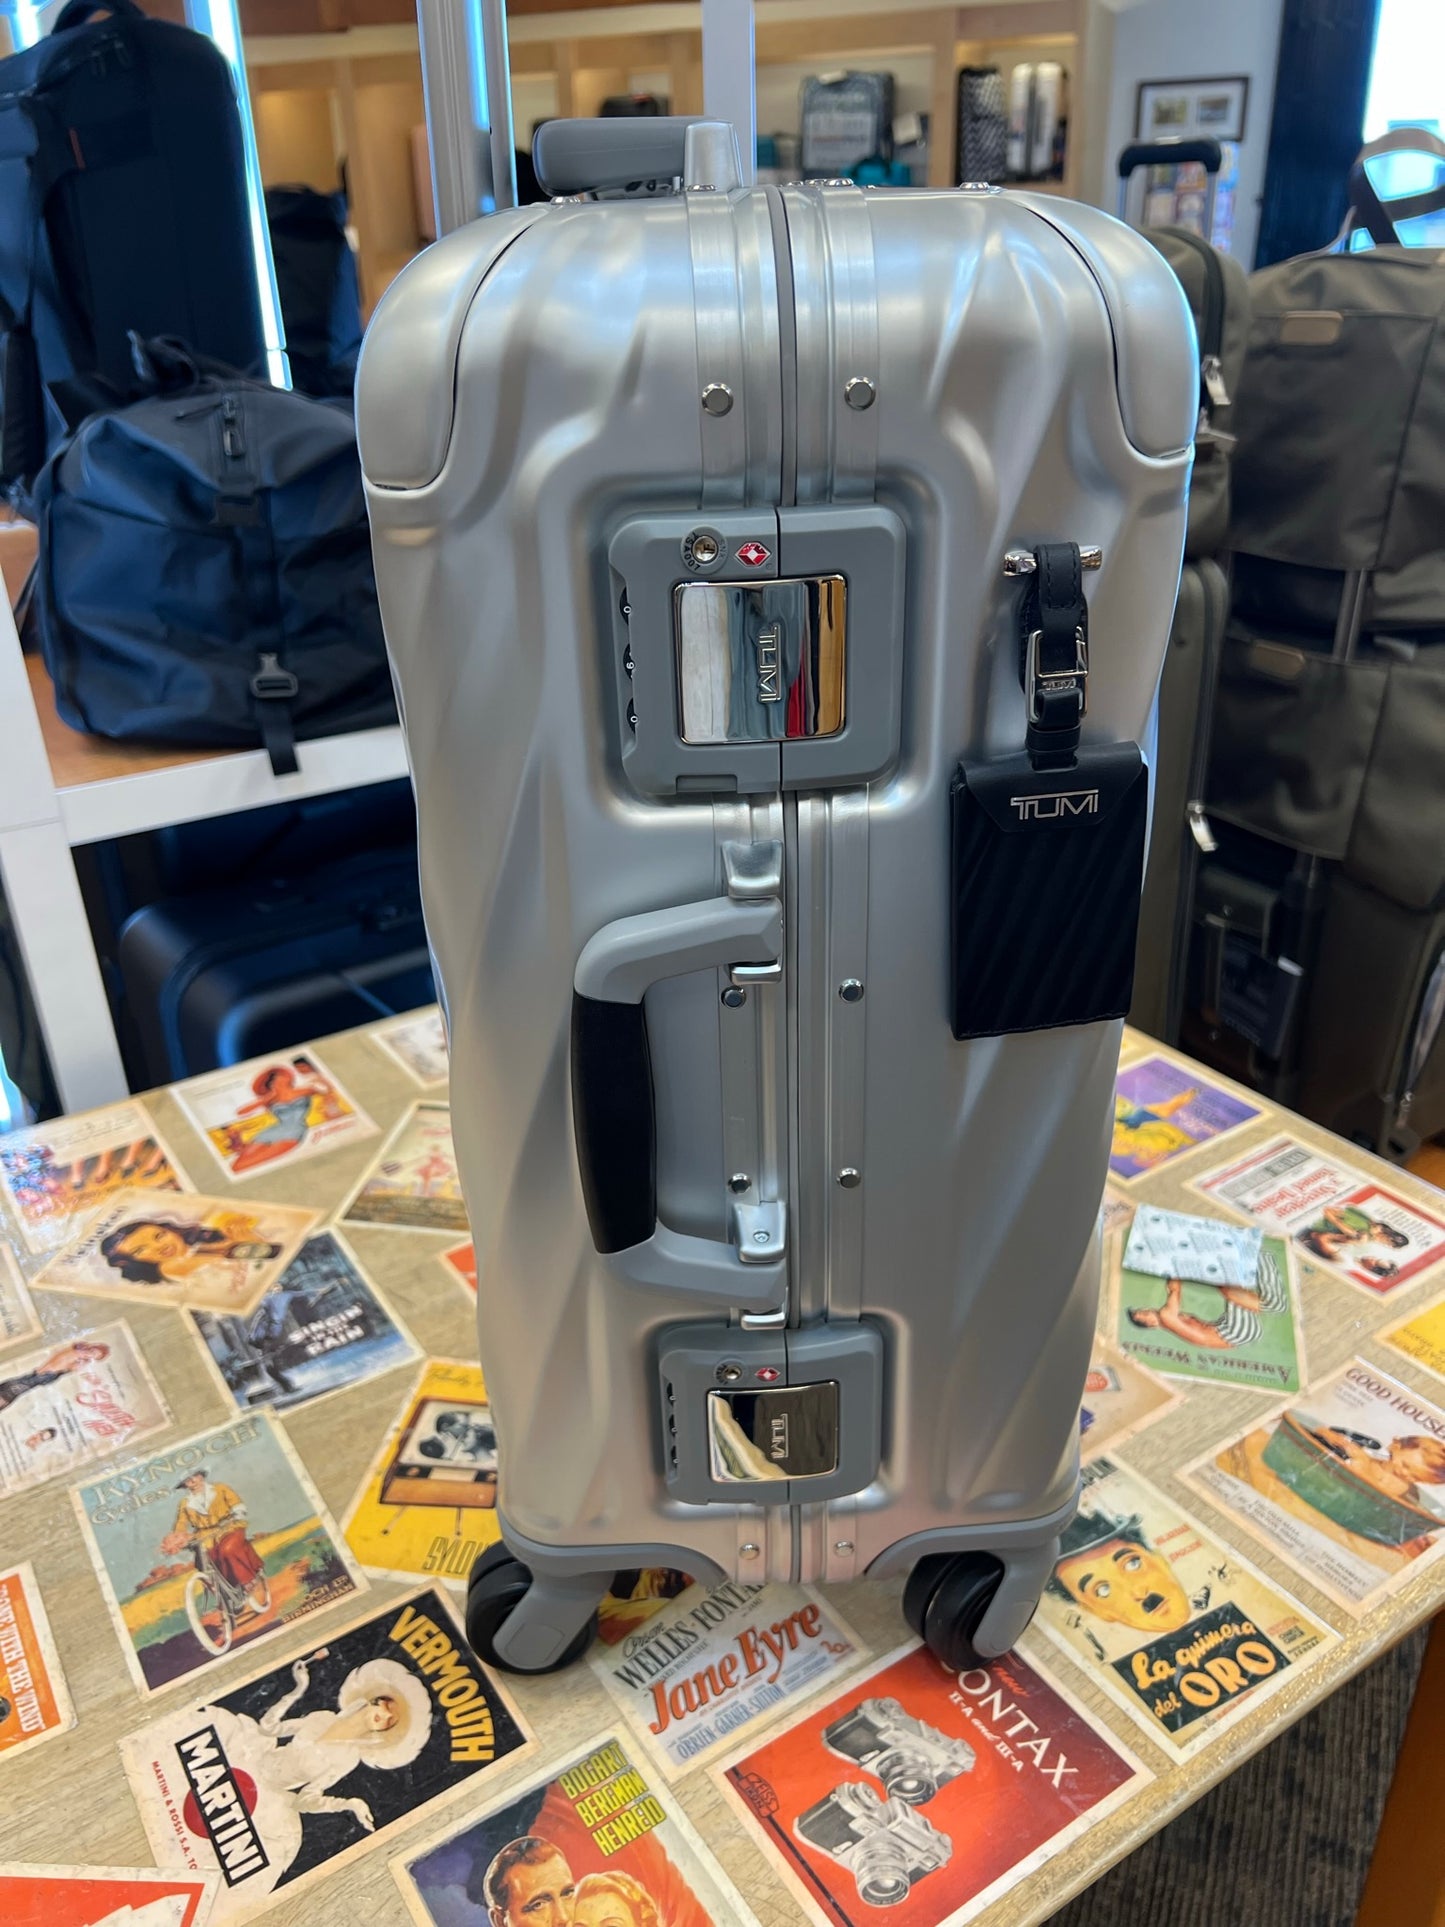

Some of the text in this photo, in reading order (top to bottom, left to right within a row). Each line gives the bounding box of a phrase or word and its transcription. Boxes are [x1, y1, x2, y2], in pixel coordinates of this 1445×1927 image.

[759, 624, 782, 703] TUMI
[1042, 678, 1077, 691] TUMI
[1010, 789, 1099, 821] TUMI
[305, 1325, 365, 1356] RAIN
[1346, 1368, 1391, 1400] GOOD
[91, 1417, 261, 1506] KYNOCH
[770, 1413, 789, 1459] TUMI
[90, 1485, 172, 1526] Cycles
[6, 1657, 34, 1695] THE
[613, 1619, 699, 1690] WELLES
[648, 1651, 740, 1734] Jane
[735, 1602, 823, 1684] Eyre
[1131, 1651, 1176, 1690] La
[1175, 1620, 1257, 1669] quimera
[1154, 1691, 1182, 1718] del
[1179, 1640, 1277, 1708] ORO
[388, 1605, 495, 1762] VERMOUTH
[14, 1688, 47, 1734] WIND
[949, 1690, 1024, 1772] II-A and III-A
[151, 1760, 171, 1798] MARTINI
[559, 1740, 628, 1800] BOGART
[165, 1798, 173, 1806] &
[168, 1807, 185, 1836] ROSSI
[180, 1731, 265, 1881] MARTINI
[574, 1767, 649, 1829] BERGMAN
[179, 1836, 192, 1857] S.A.
[591, 1795, 667, 1857] HENREID
